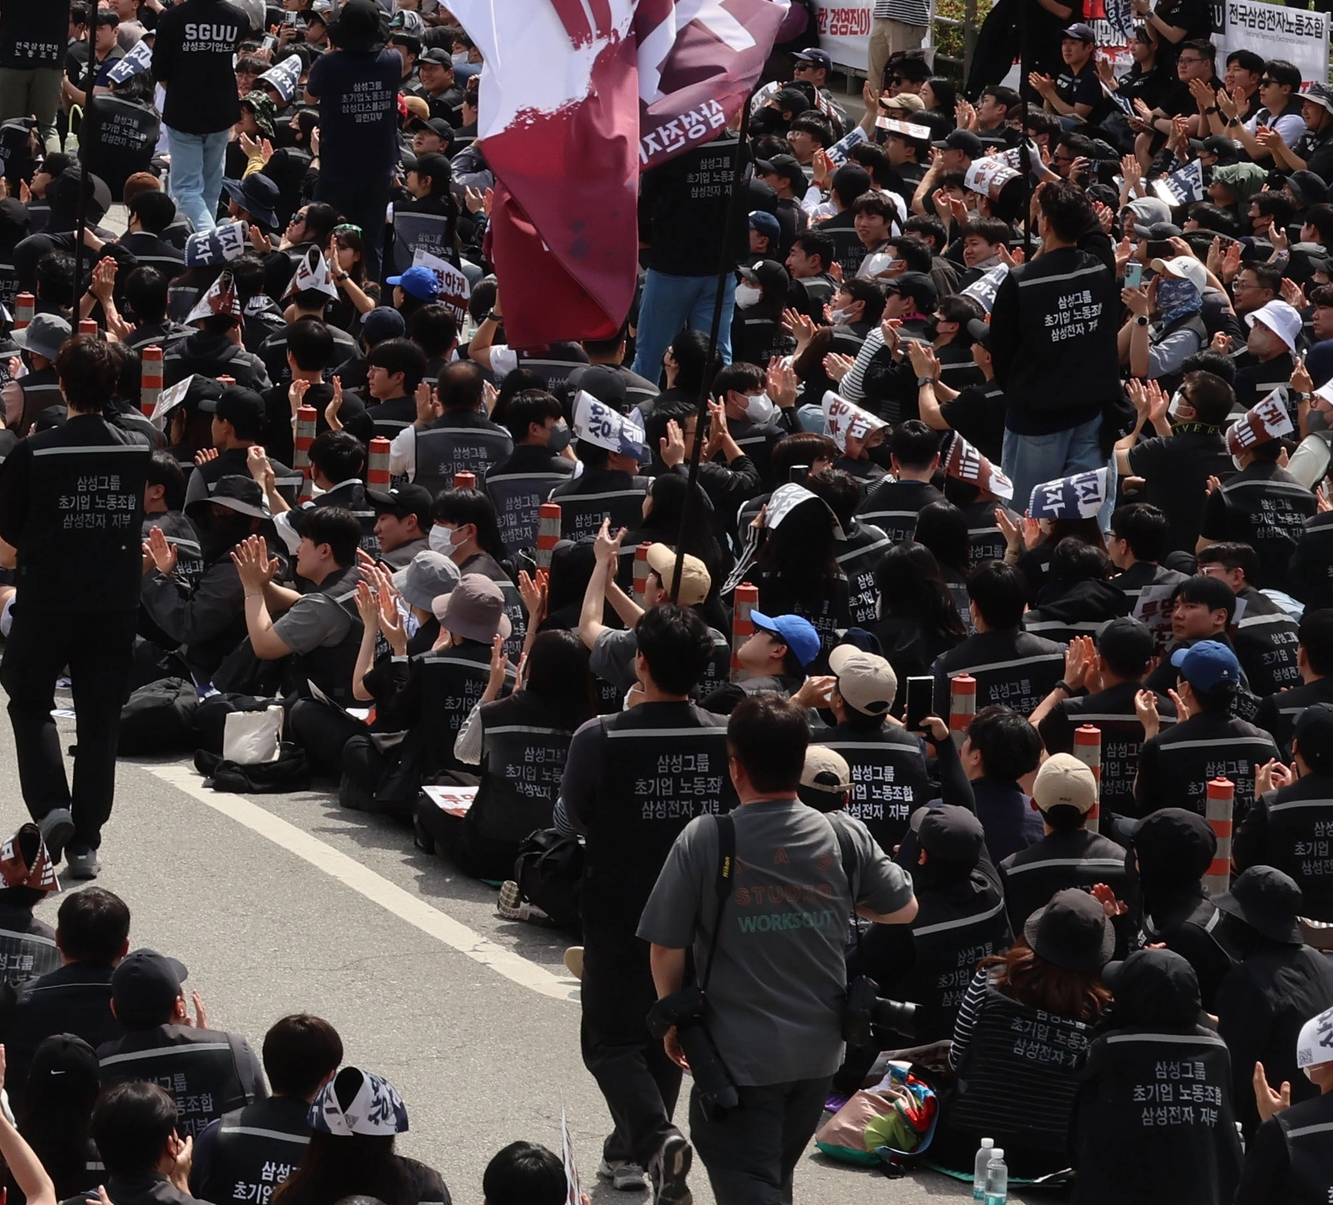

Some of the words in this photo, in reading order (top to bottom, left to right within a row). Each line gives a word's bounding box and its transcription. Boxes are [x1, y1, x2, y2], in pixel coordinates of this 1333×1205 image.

[830, 9, 871, 36] 경영진이
[1229, 3, 1325, 40] 전국삼성전자노동조합
[15, 41, 59, 53] 전국삼성전자
[271, 69, 295, 94] 하자
[353, 80, 382, 92] 삼성그룹
[342, 101, 391, 114] 삼성디스플레이
[114, 114, 140, 129] 삼성그룹
[355, 112, 383, 123] 열린지부
[100, 121, 120, 134] 초기업
[101, 132, 128, 147] 삼성전자
[700, 156, 731, 170] 삼성그룹
[687, 171, 710, 185] 초기업
[691, 185, 721, 199] 삼성전자
[195, 230, 214, 266] 하자
[1058, 290, 1092, 309] 삼성그룹
[1044, 311, 1071, 328] 초기업
[1051, 323, 1086, 343] 삼성전자
[453, 446, 488, 459] 삼성그룹
[76, 474, 120, 492] 삼성그룹
[59, 495, 91, 511] 초기업
[95, 493, 137, 511] 노동조합
[505, 494, 540, 511] 삼성그룹
[1042, 479, 1065, 515] 하자
[63, 514, 107, 530] 삼성전자
[111, 513, 132, 529] 지부
[496, 514, 519, 529] 초기업
[500, 528, 533, 544] 삼성전자
[1262, 649, 1289, 666] 초기업
[989, 678, 1032, 698] 삼성그룹
[506, 764, 537, 779] 초기업
[657, 755, 710, 773] 삼성그룹
[1205, 759, 1249, 776] 삼성그룹
[852, 765, 894, 783] 삼성그룹
[634, 777, 673, 796] 초기업
[872, 784, 914, 802] 노동조합
[641, 800, 694, 820] 삼성전자
[889, 803, 910, 819] 지부
[1294, 839, 1329, 857] 초기업
[737, 883, 833, 906] STUDIO
[737, 910, 832, 934] WORKSOUT
[938, 969, 971, 989] 초기업
[1011, 1016, 1053, 1035] 초기업
[1013, 1038, 1064, 1064] 삼성전자
[1155, 1060, 1206, 1081] 삼성그룹
[1133, 1083, 1172, 1104] 초기업
[1179, 1084, 1222, 1107] 노동조합
[1142, 1105, 1195, 1127] 삼성전자
[1199, 1106, 1219, 1129] 지부
